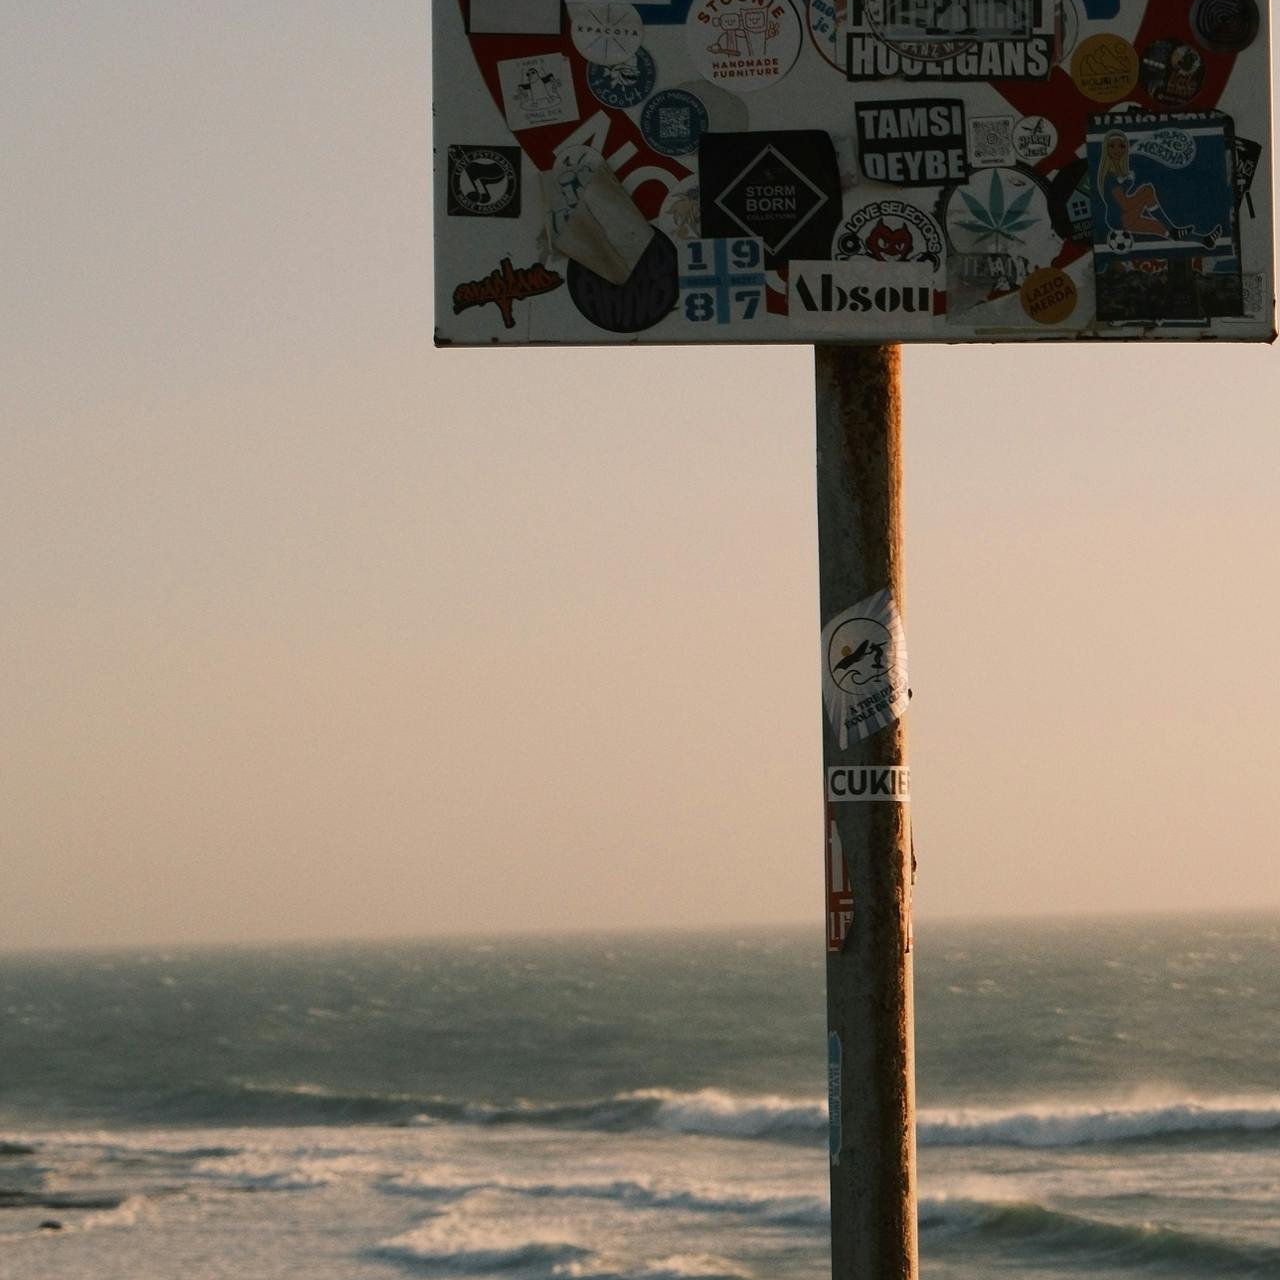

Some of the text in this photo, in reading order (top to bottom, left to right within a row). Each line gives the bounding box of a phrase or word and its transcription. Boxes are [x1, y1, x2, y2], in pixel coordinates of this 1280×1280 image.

[712, 58, 779, 70] HANDMADE
[713, 67, 780, 80] FURNITURE
[859, 105, 962, 140] TAMSI
[745, 184, 796, 198] STORM
[746, 198, 797, 212] BORN
[845, 201, 942, 254] LOVE SELECTORS
[1025, 275, 1065, 302] LAZIO
[1028, 286, 1075, 317] MERDA
[857, 691, 879, 711] TIRE
